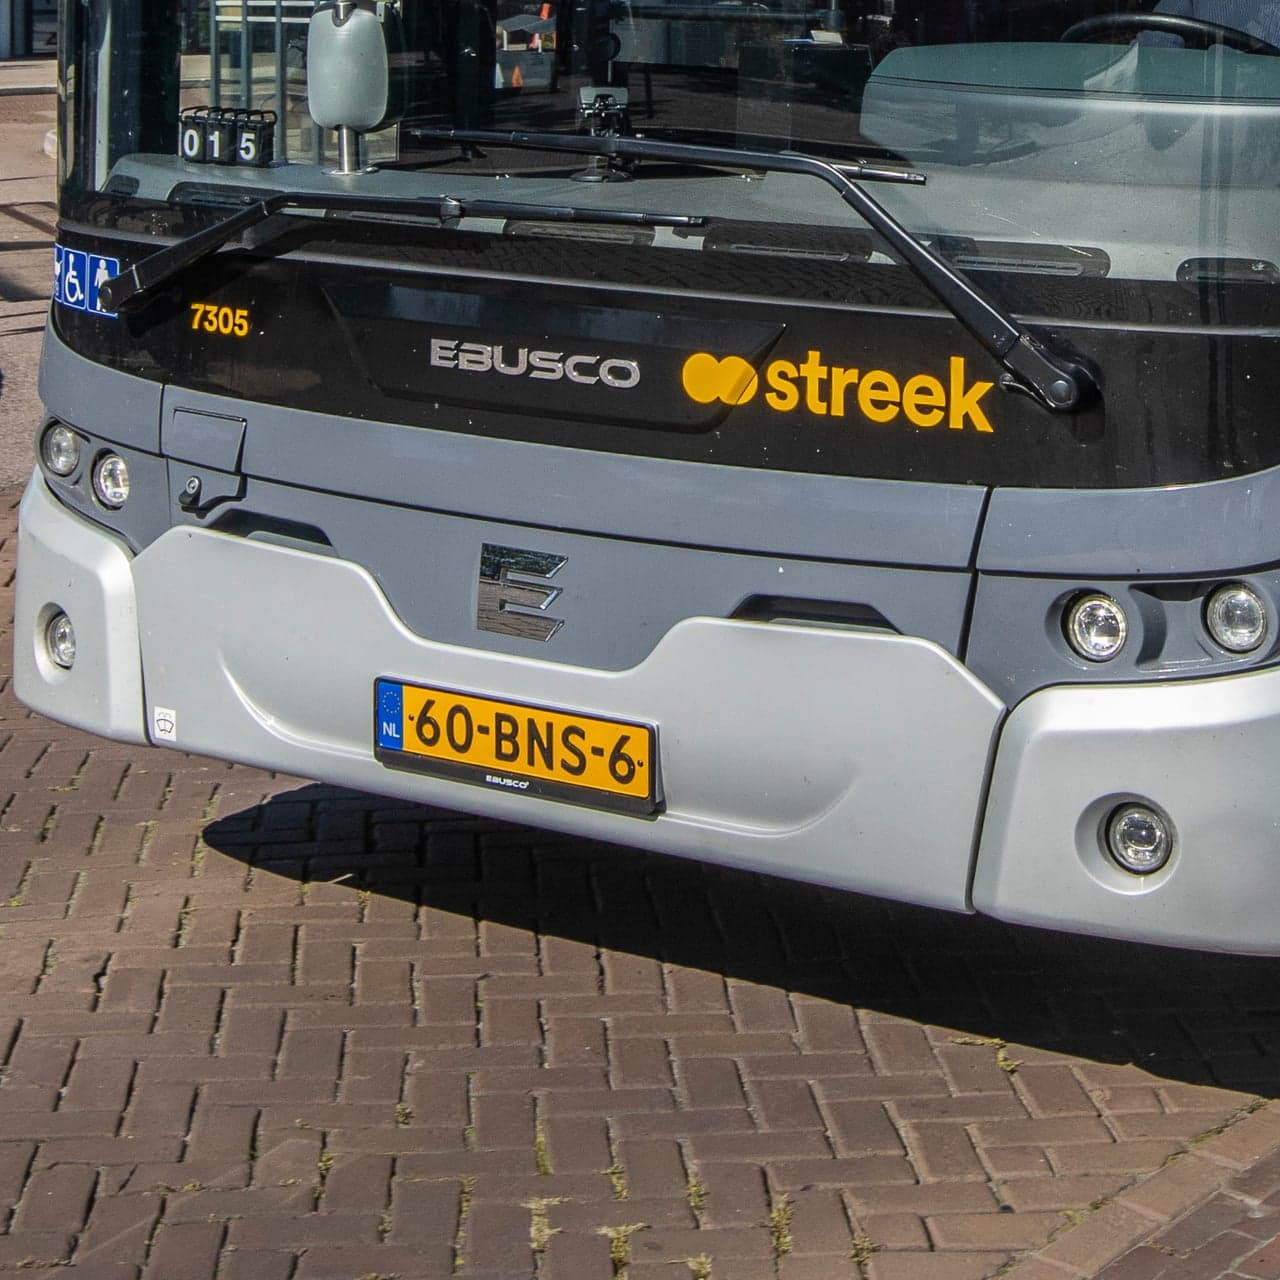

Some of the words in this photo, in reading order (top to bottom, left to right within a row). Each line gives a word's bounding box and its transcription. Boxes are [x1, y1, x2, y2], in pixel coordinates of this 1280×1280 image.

[190, 303, 250, 337] 7305
[429, 337, 642, 390] EBUSCO
[764, 350, 996, 434] streek
[382, 721, 401, 739] NL
[415, 698, 638, 785] 60-BNS-6
